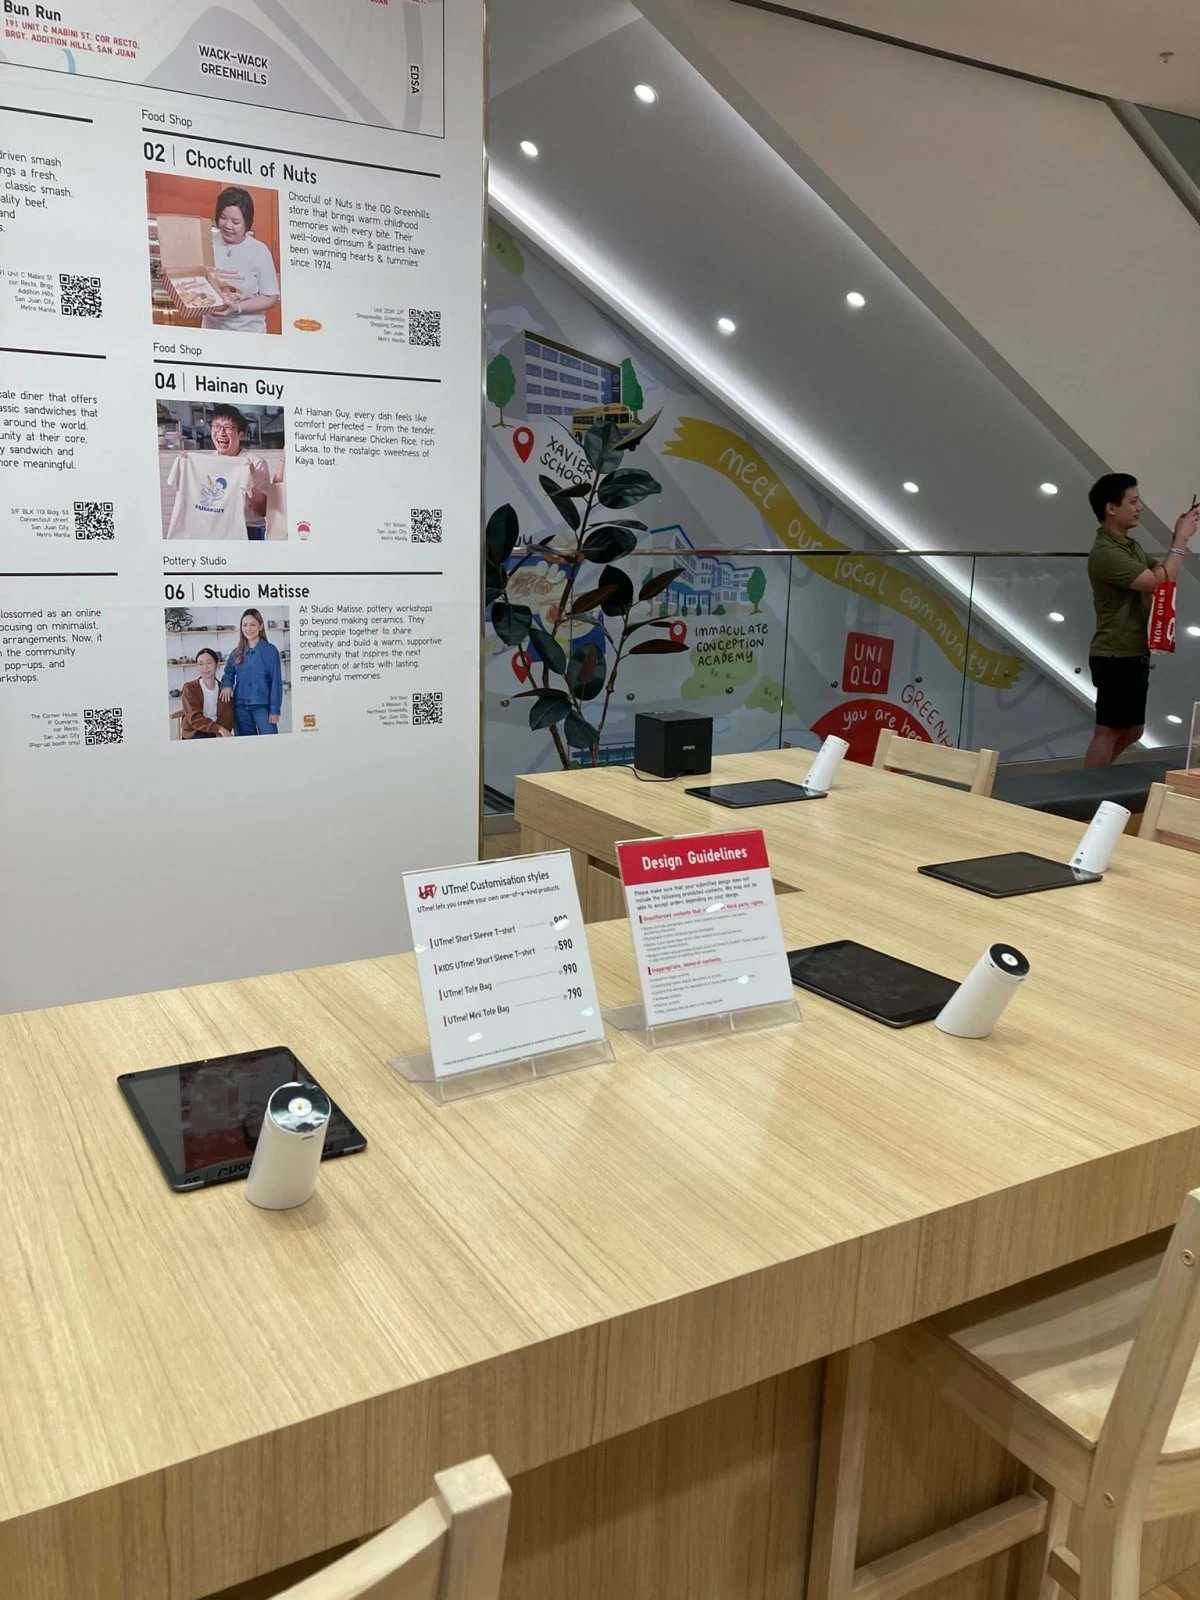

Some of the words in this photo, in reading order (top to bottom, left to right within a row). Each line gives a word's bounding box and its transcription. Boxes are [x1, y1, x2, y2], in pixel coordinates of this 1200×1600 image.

[3, 0, 29, 17] Bun
[35, 4, 61, 22] Run
[5, 18, 18, 28] 191
[21, 21, 40, 31] UNIT
[42, 25, 48, 33] C
[51, 26, 78, 38] MABINI
[95, 34, 110, 44] COR
[31, 34, 67, 47] ADDITION
[96, 44, 113, 55] SAN
[114, 48, 136, 59] JUAN
[198, 45, 268, 69] WACK-WACK
[201, 62, 267, 85] GREENHILLS
[410, 65, 420, 94] EDSA
[141, 109, 165, 123] Food
[169, 113, 193, 129] Shop
[143, 141, 166, 163] 02
[186, 149, 253, 175] Chocfull
[260, 162, 275, 178] of
[283, 163, 317, 185] Nuts
[4, 180, 37, 193] classic
[288, 191, 321, 204] Chocfull
[323, 196, 332, 206] of
[335, 198, 353, 209] Nuts
[364, 202, 377, 212] the
[379, 203, 391, 214] OG
[393, 205, 430, 219] Greenhills
[288, 205, 309, 216] store
[312, 207, 328, 219] that
[331, 210, 355, 224] brings
[357, 216, 381, 225] warm
[383, 218, 419, 230] childhood
[289, 232, 331, 245] well-loved
[333, 237, 365, 248] dimsum
[367, 240, 374, 250] &
[376, 243, 406, 254] pastries
[408, 245, 426, 256] have
[290, 257, 310, 268] since
[153, 342, 176, 354] Food
[179, 344, 202, 358] Shop
[155, 372, 177, 390] 04
[195, 375, 248, 394] Hainan
[255, 379, 284, 400] Guy
[20, 390, 44, 401] diner
[48, 392, 67, 403] that
[70, 393, 98, 405] offers
[23, 405, 77, 417] sandwiches
[80, 407, 98, 418] that
[293, 406, 303, 415] At
[306, 407, 333, 417] Hainan
[354, 411, 375, 422] every
[377, 411, 393, 421] dish
[395, 412, 413, 422] feels
[414, 413, 428, 423] like
[3, 418, 37, 428] around
[41, 419, 56, 429] the
[294, 431, 327, 441] flavorful
[329, 433, 367, 443] Hainanese
[369, 434, 399, 445] Chicken
[420, 437, 435, 446] rich
[295, 455, 314, 467] Kaya
[323, 445, 331, 454] to
[333, 445, 346, 454] the
[348, 446, 381, 458] nostalgic
[383, 448, 420, 458] sweetness
[422, 449, 430, 458] of
[546, 435, 594, 480] XAVIER
[540, 452, 587, 485] SCHOO
[163, 555, 197, 568] Pottery
[199, 556, 227, 566] Studio
[834, 556, 888, 595] local
[164, 584, 185, 600] 06
[204, 584, 250, 599] Studio
[258, 583, 310, 599] Matisse
[299, 605, 308, 613] At
[311, 604, 334, 614] Studio
[366, 604, 393, 615] pottery
[395, 604, 433, 613] workshops
[1157, 590, 1166, 615] OPEN
[299, 618, 309, 627] go
[311, 617, 339, 627] beyond
[341, 616, 368, 626] making
[408, 615, 425, 625] They
[1154, 620, 1162, 642] NOW
[96, 633, 102, 642] it
[854, 643, 882, 663] UNI
[48, 659, 65, 669] and
[300, 673, 342, 683] meaningful
[850, 665, 882, 686] QLO
[842, 709, 868, 730] you
[874, 709, 896, 728] are
[641, 854, 683, 871] Design
[687, 847, 748, 865] Guidelines
[442, 882, 469, 896] UTme!
[470, 875, 526, 891] Customisation
[527, 871, 550, 884] styles
[416, 904, 435, 913] UTme!
[457, 898, 475, 907] create
[499, 888, 538, 900] one-of-a-kind
[434, 936, 454, 947] UTme!
[455, 934, 473, 943] Short
[474, 931, 494, 940] Sleeve
[494, 926, 516, 936] T-shirt
[438, 962, 454, 972] KIDS
[455, 959, 475, 970] UTme!
[476, 955, 493, 965] Short
[494, 953, 514, 962] Sleeve
[514, 947, 536, 957] T-shirt
[443, 988, 464, 999] UTme!
[464, 985, 478, 994] Tote
[479, 983, 492, 991] Bag
[448, 1013, 468, 1024] UTme!
[469, 1011, 481, 1020] Mini
[482, 1008, 496, 1016] Tote
[497, 1005, 510, 1014] Bag
